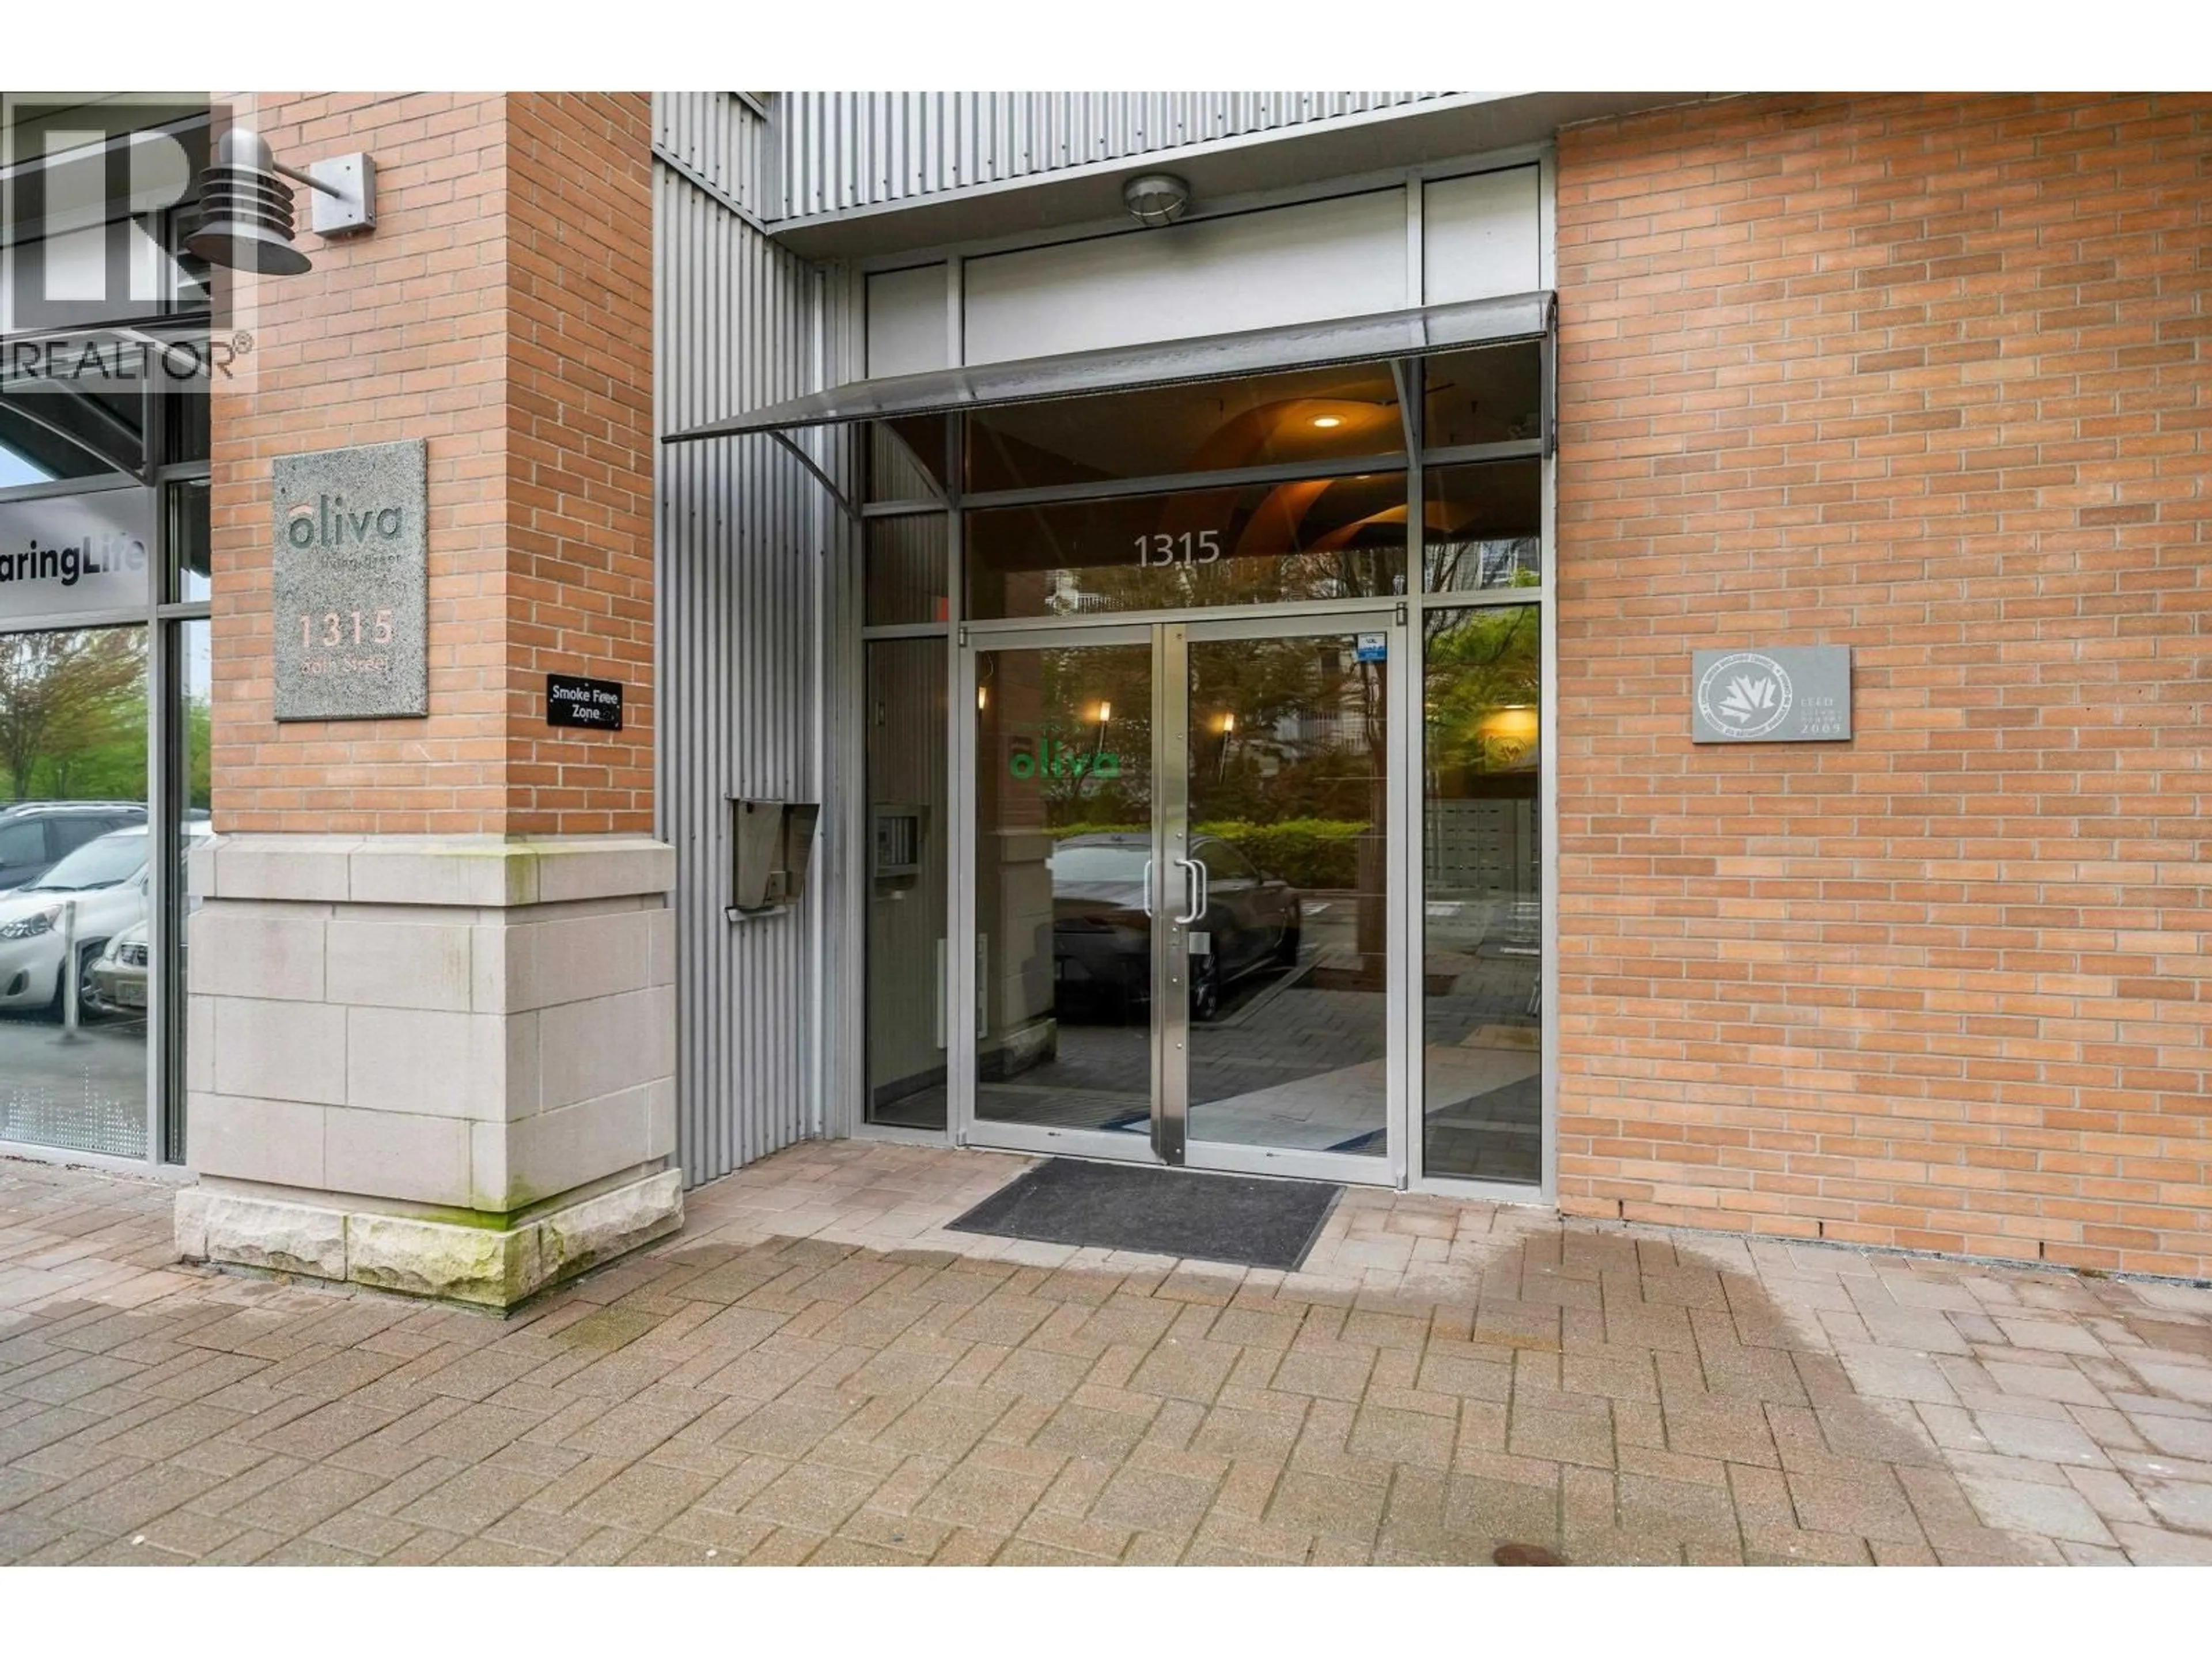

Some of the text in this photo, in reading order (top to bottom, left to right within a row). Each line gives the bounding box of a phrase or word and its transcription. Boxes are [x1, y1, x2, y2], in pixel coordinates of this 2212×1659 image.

[1134, 530, 1219, 567] 1315
[300, 609, 393, 648] 1315
[553, 685, 618, 704] Smoke Free
[572, 704, 600, 719] Zone
